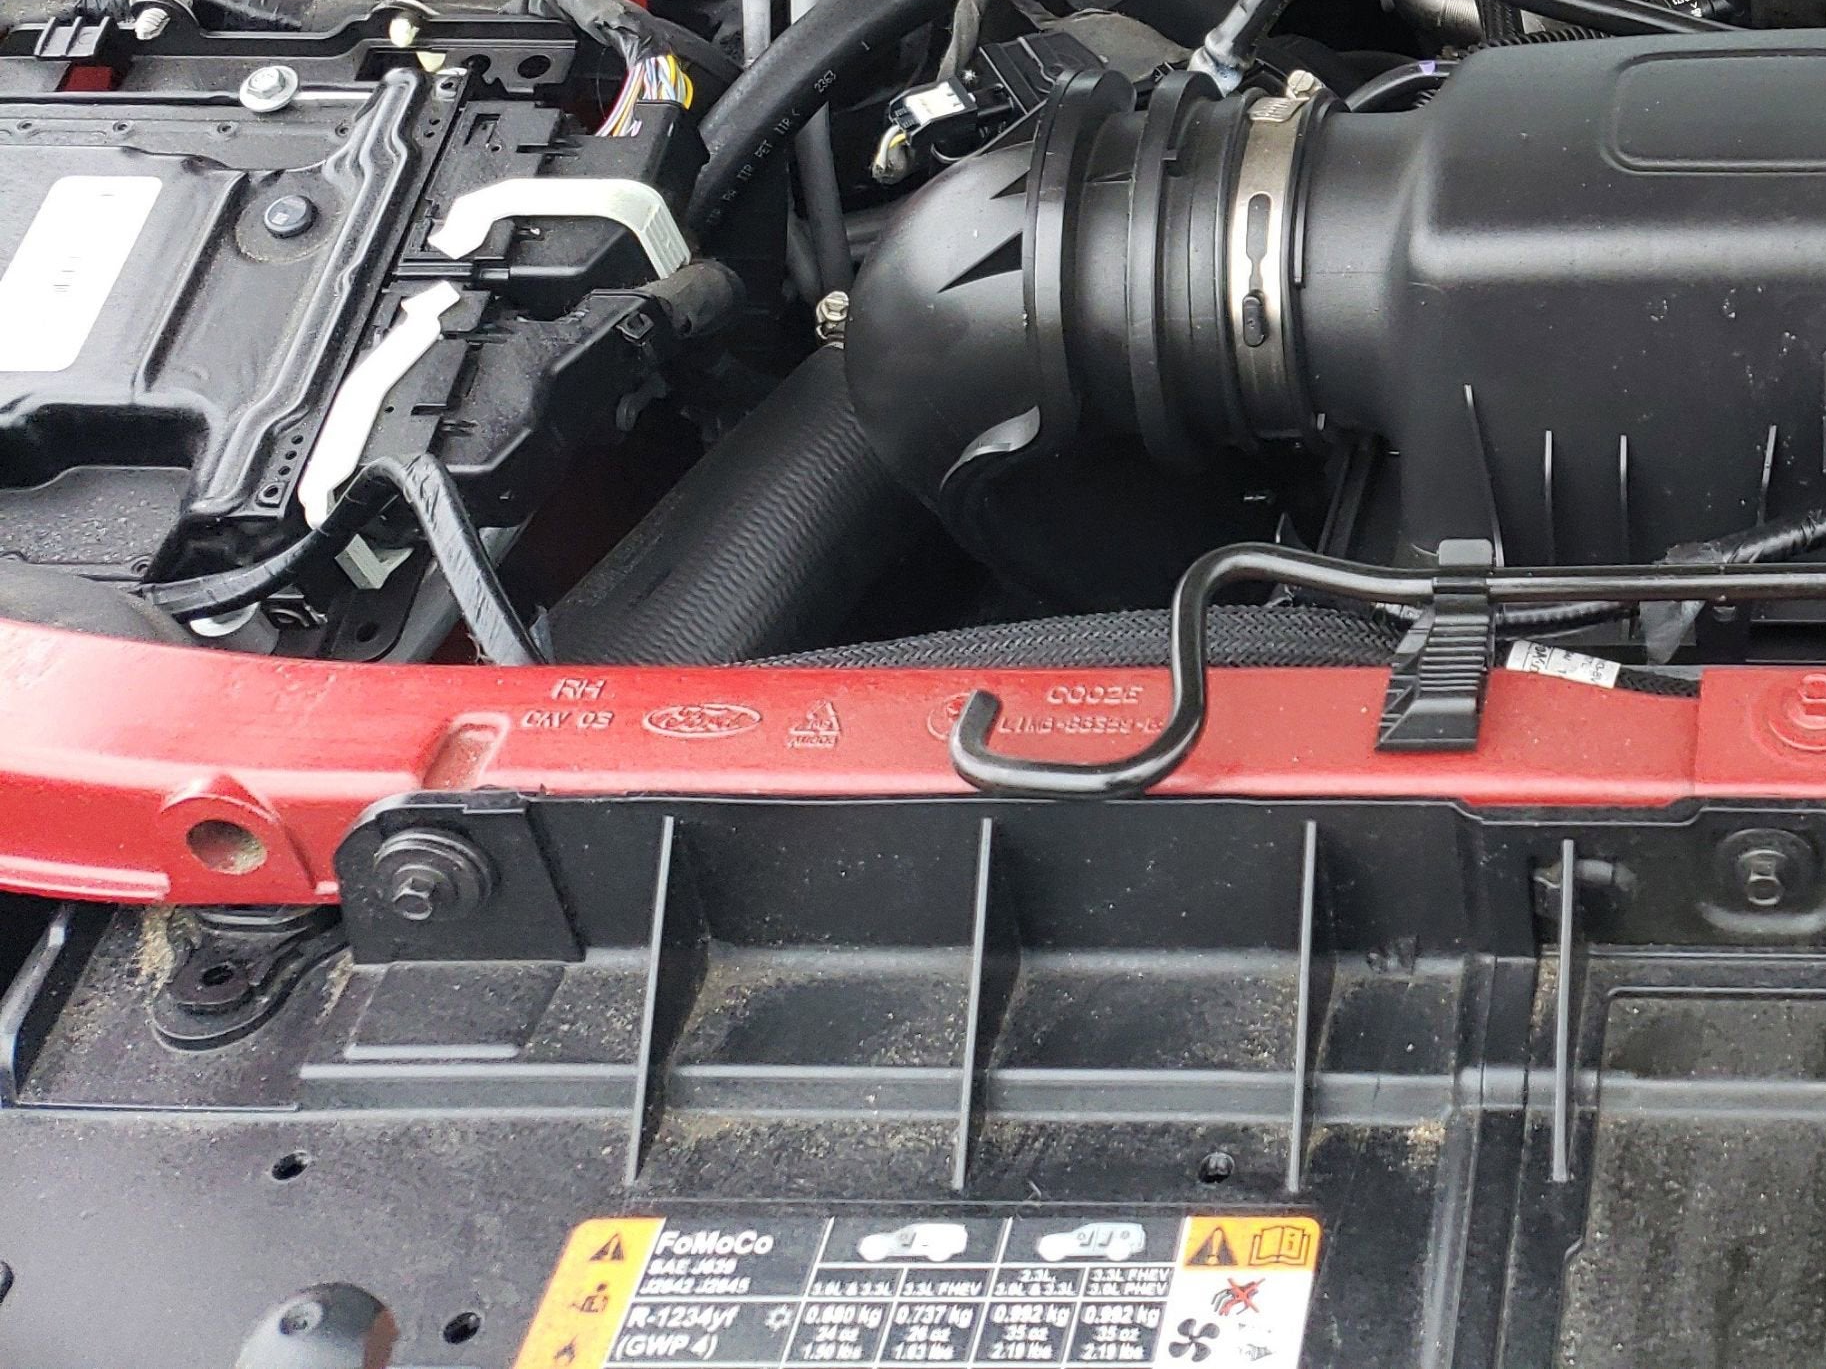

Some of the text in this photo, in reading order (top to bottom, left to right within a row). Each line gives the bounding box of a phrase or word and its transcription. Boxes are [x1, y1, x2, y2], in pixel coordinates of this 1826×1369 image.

[551, 678, 607, 700] RH
[655, 1229, 774, 1255] FoMoCo
[626, 1304, 741, 1332] R-1234yf
[948, 1303, 975, 1329] kg
[1045, 1303, 1071, 1328] kg
[1135, 1303, 1161, 1328] kg
[615, 1333, 690, 1361] (GWP
